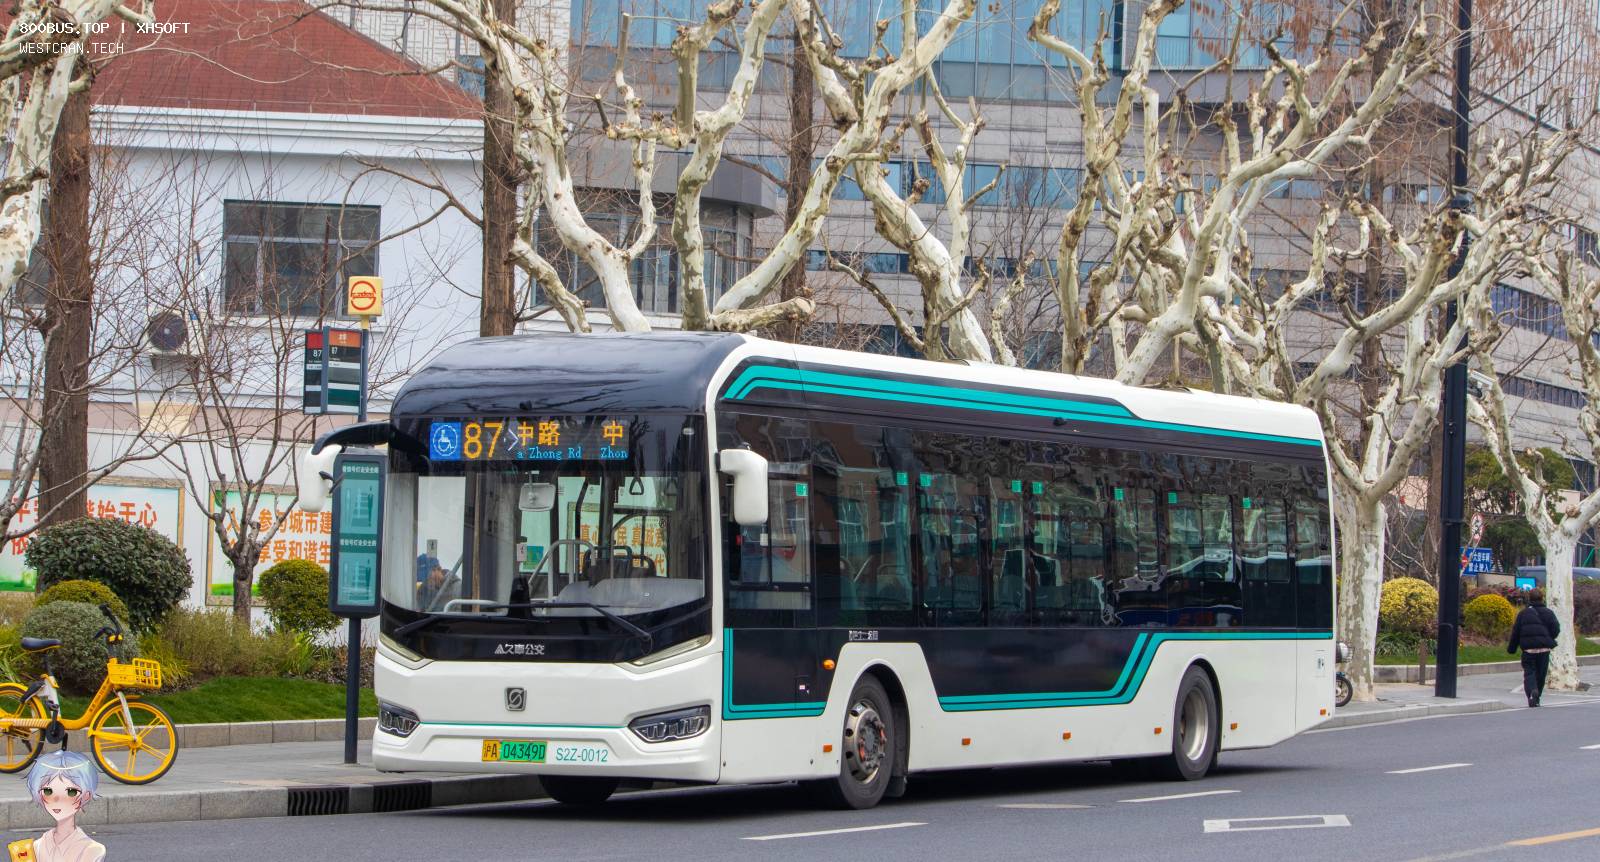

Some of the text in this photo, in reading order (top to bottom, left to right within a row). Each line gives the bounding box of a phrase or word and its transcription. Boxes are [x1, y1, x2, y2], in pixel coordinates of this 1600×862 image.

[312, 349, 322, 358] 87
[463, 422, 503, 459] 87
[603, 420, 624, 446] 中
[529, 447, 562, 460] Zhong
[568, 447, 582, 458] Rd
[600, 447, 629, 458] Zhon
[503, 743, 546, 760] 04349D
[556, 748, 609, 763] S2Z-0012
